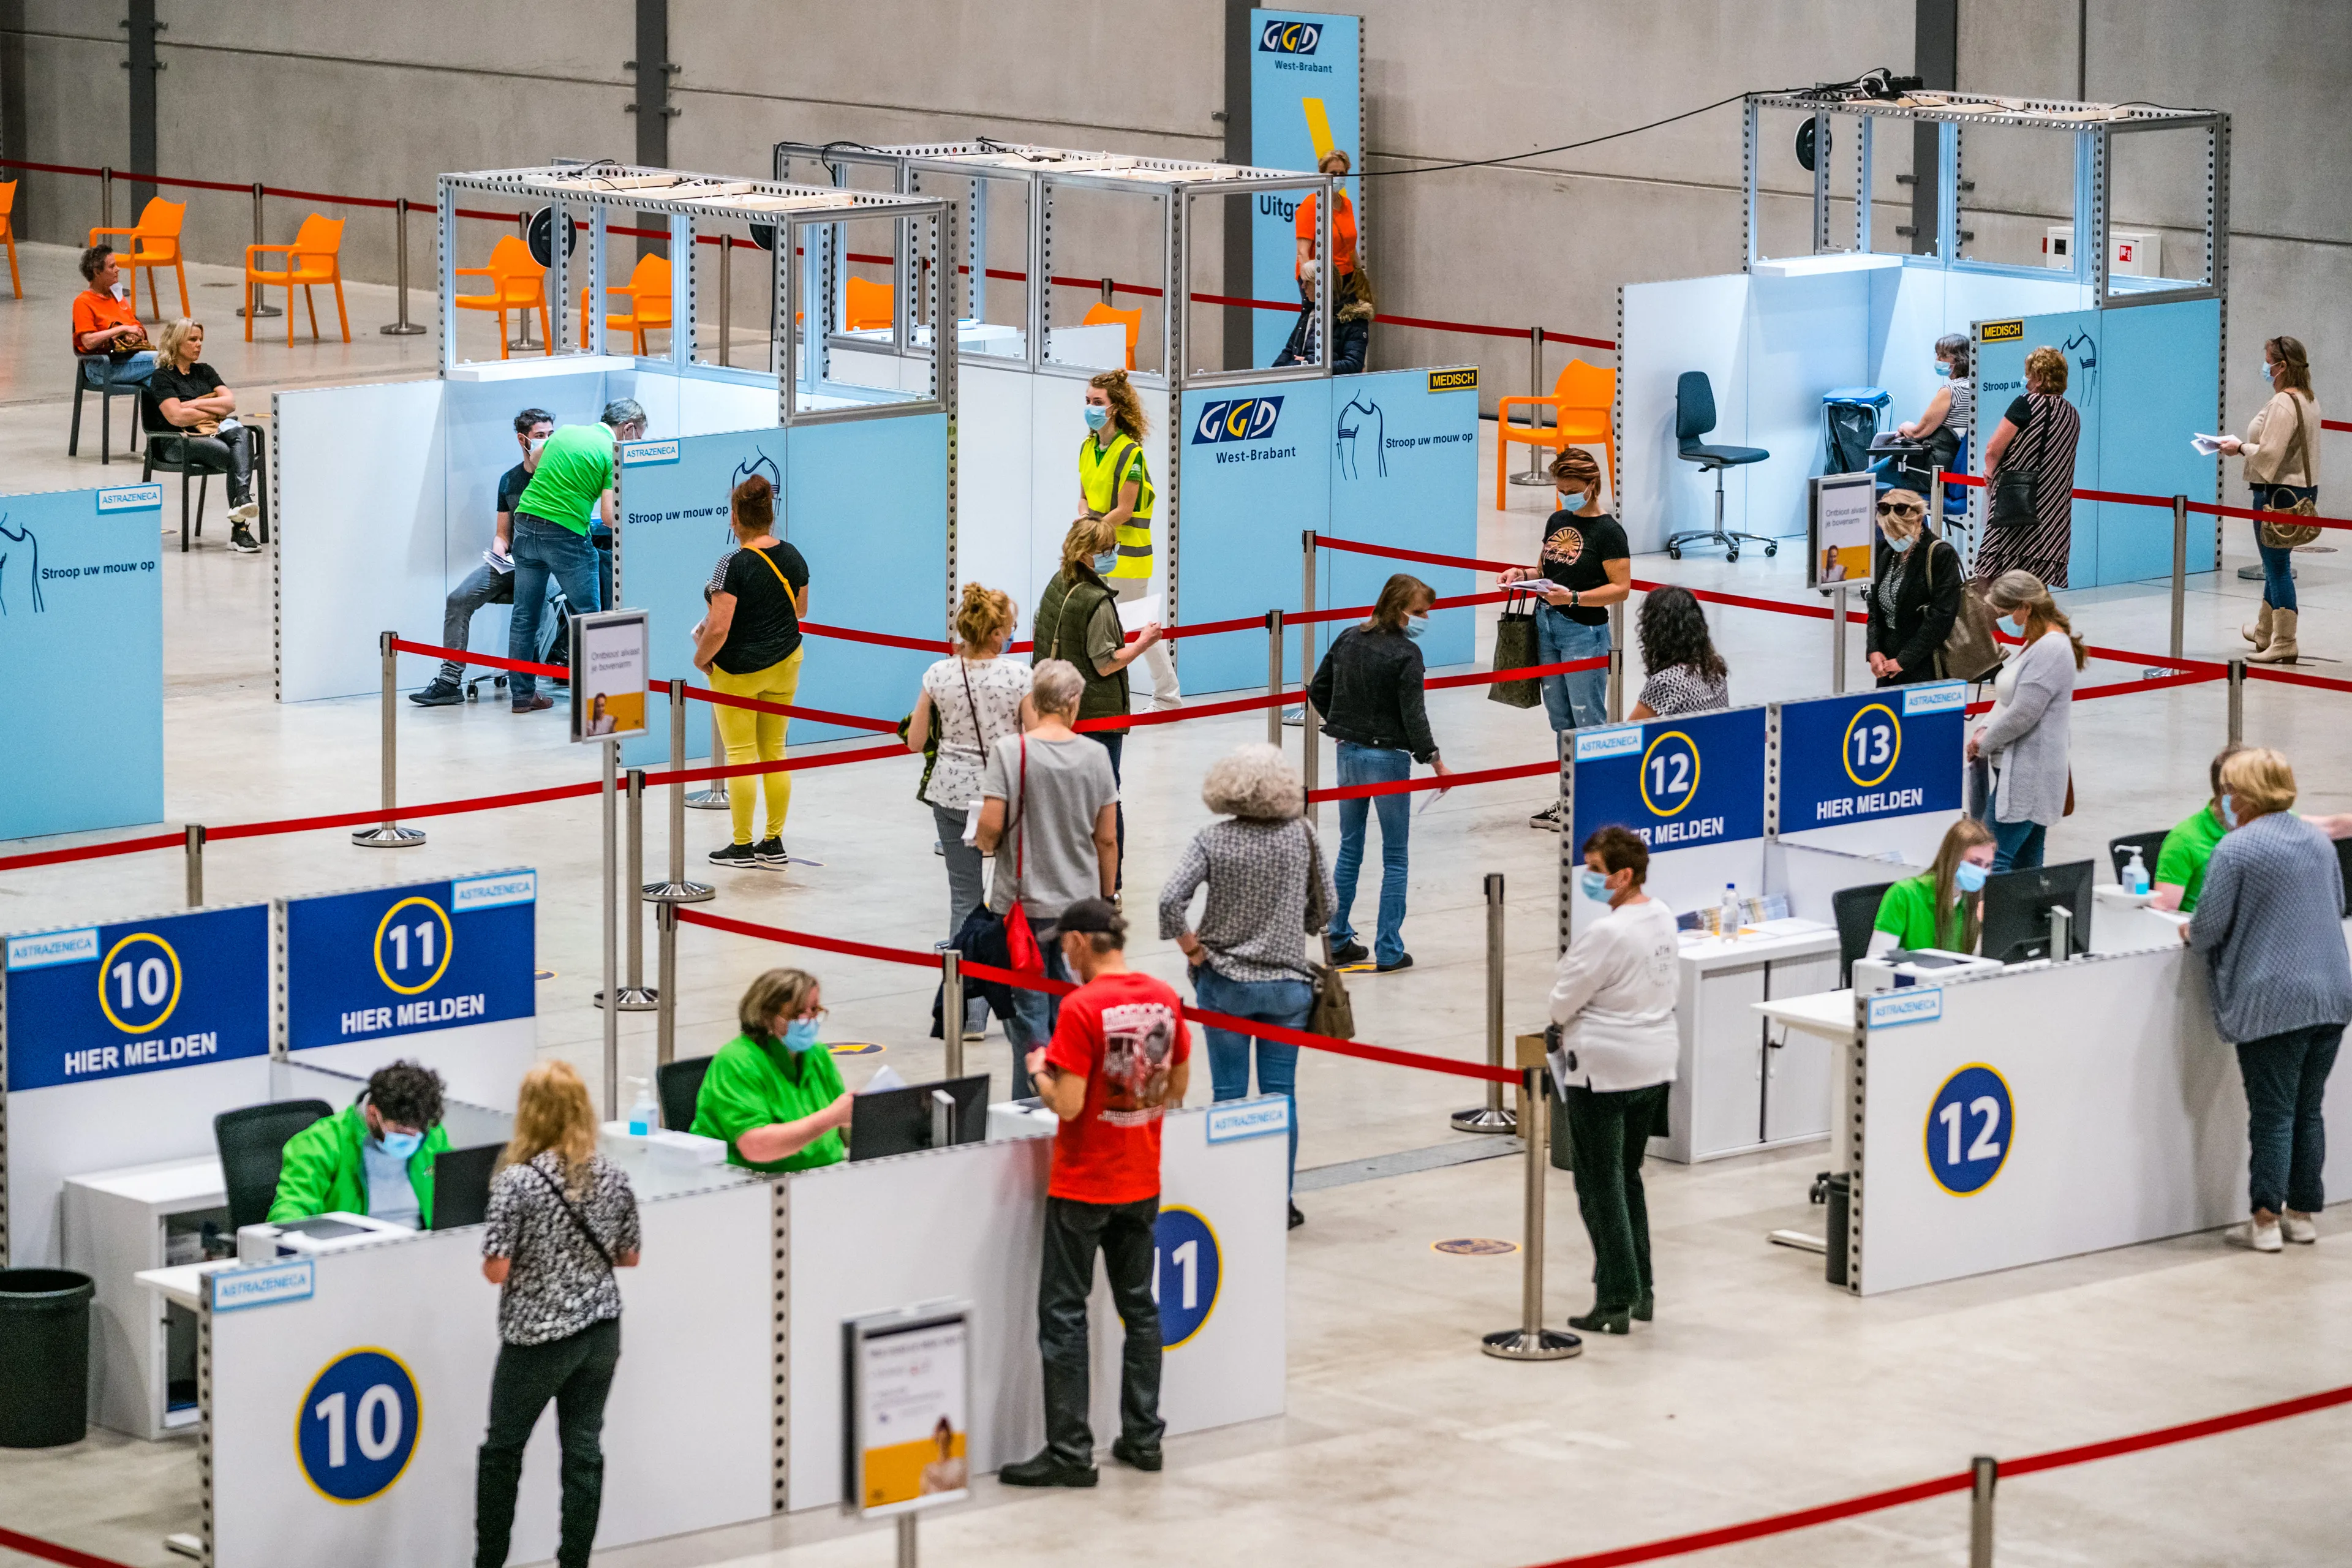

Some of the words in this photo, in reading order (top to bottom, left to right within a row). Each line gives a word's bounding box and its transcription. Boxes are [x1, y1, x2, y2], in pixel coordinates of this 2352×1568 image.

[1263, 22, 1319, 53] GGD
[1275, 60, 1333, 74] West-Brabant
[1259, 194, 1302, 223] Uitg
[1984, 324, 2021, 337] MEDISCH
[1433, 372, 1474, 387] MEDISCH
[1983, 382, 2009, 392] Stroop
[1199, 400, 1277, 440] GGD
[1385, 438, 1415, 448] Stroop
[1418, 437, 1431, 445] uw
[1433, 434, 1460, 444] mouw
[1462, 432, 1473, 443] op
[626, 446, 676, 458] ASTRAZENECA
[1216, 446, 1296, 464] West-Brabant
[102, 491, 157, 503] ASTRAZENECA
[628, 513, 662, 524] Stroop
[666, 510, 680, 520] uw
[683, 507, 713, 519] mouw
[715, 505, 729, 518] op
[42, 568, 80, 579] Stroop
[83, 565, 100, 576] uw
[103, 562, 137, 574] mouw
[140, 560, 155, 571] op
[1907, 692, 1962, 707] ASTRAZENECA
[1580, 735, 1638, 752] ASTRAZENECA
[1853, 725, 1891, 766] 13
[1650, 752, 1690, 796] 12
[1817, 797, 1854, 821] HIER
[1856, 788, 1923, 814] MELDEN
[1655, 816, 1725, 845] MELDEN
[458, 880, 532, 900] ASTRAZENECA
[12, 937, 92, 959] ASTRAZENECA
[389, 921, 434, 970] 11
[112, 957, 169, 1009] 10
[341, 1006, 393, 1035] HIER
[396, 993, 485, 1027] MELDEN
[64, 1045, 120, 1076] HIER
[124, 1031, 218, 1067] MELDEN
[1938, 1095, 2001, 1166] 12
[314, 1383, 404, 1468] 10
